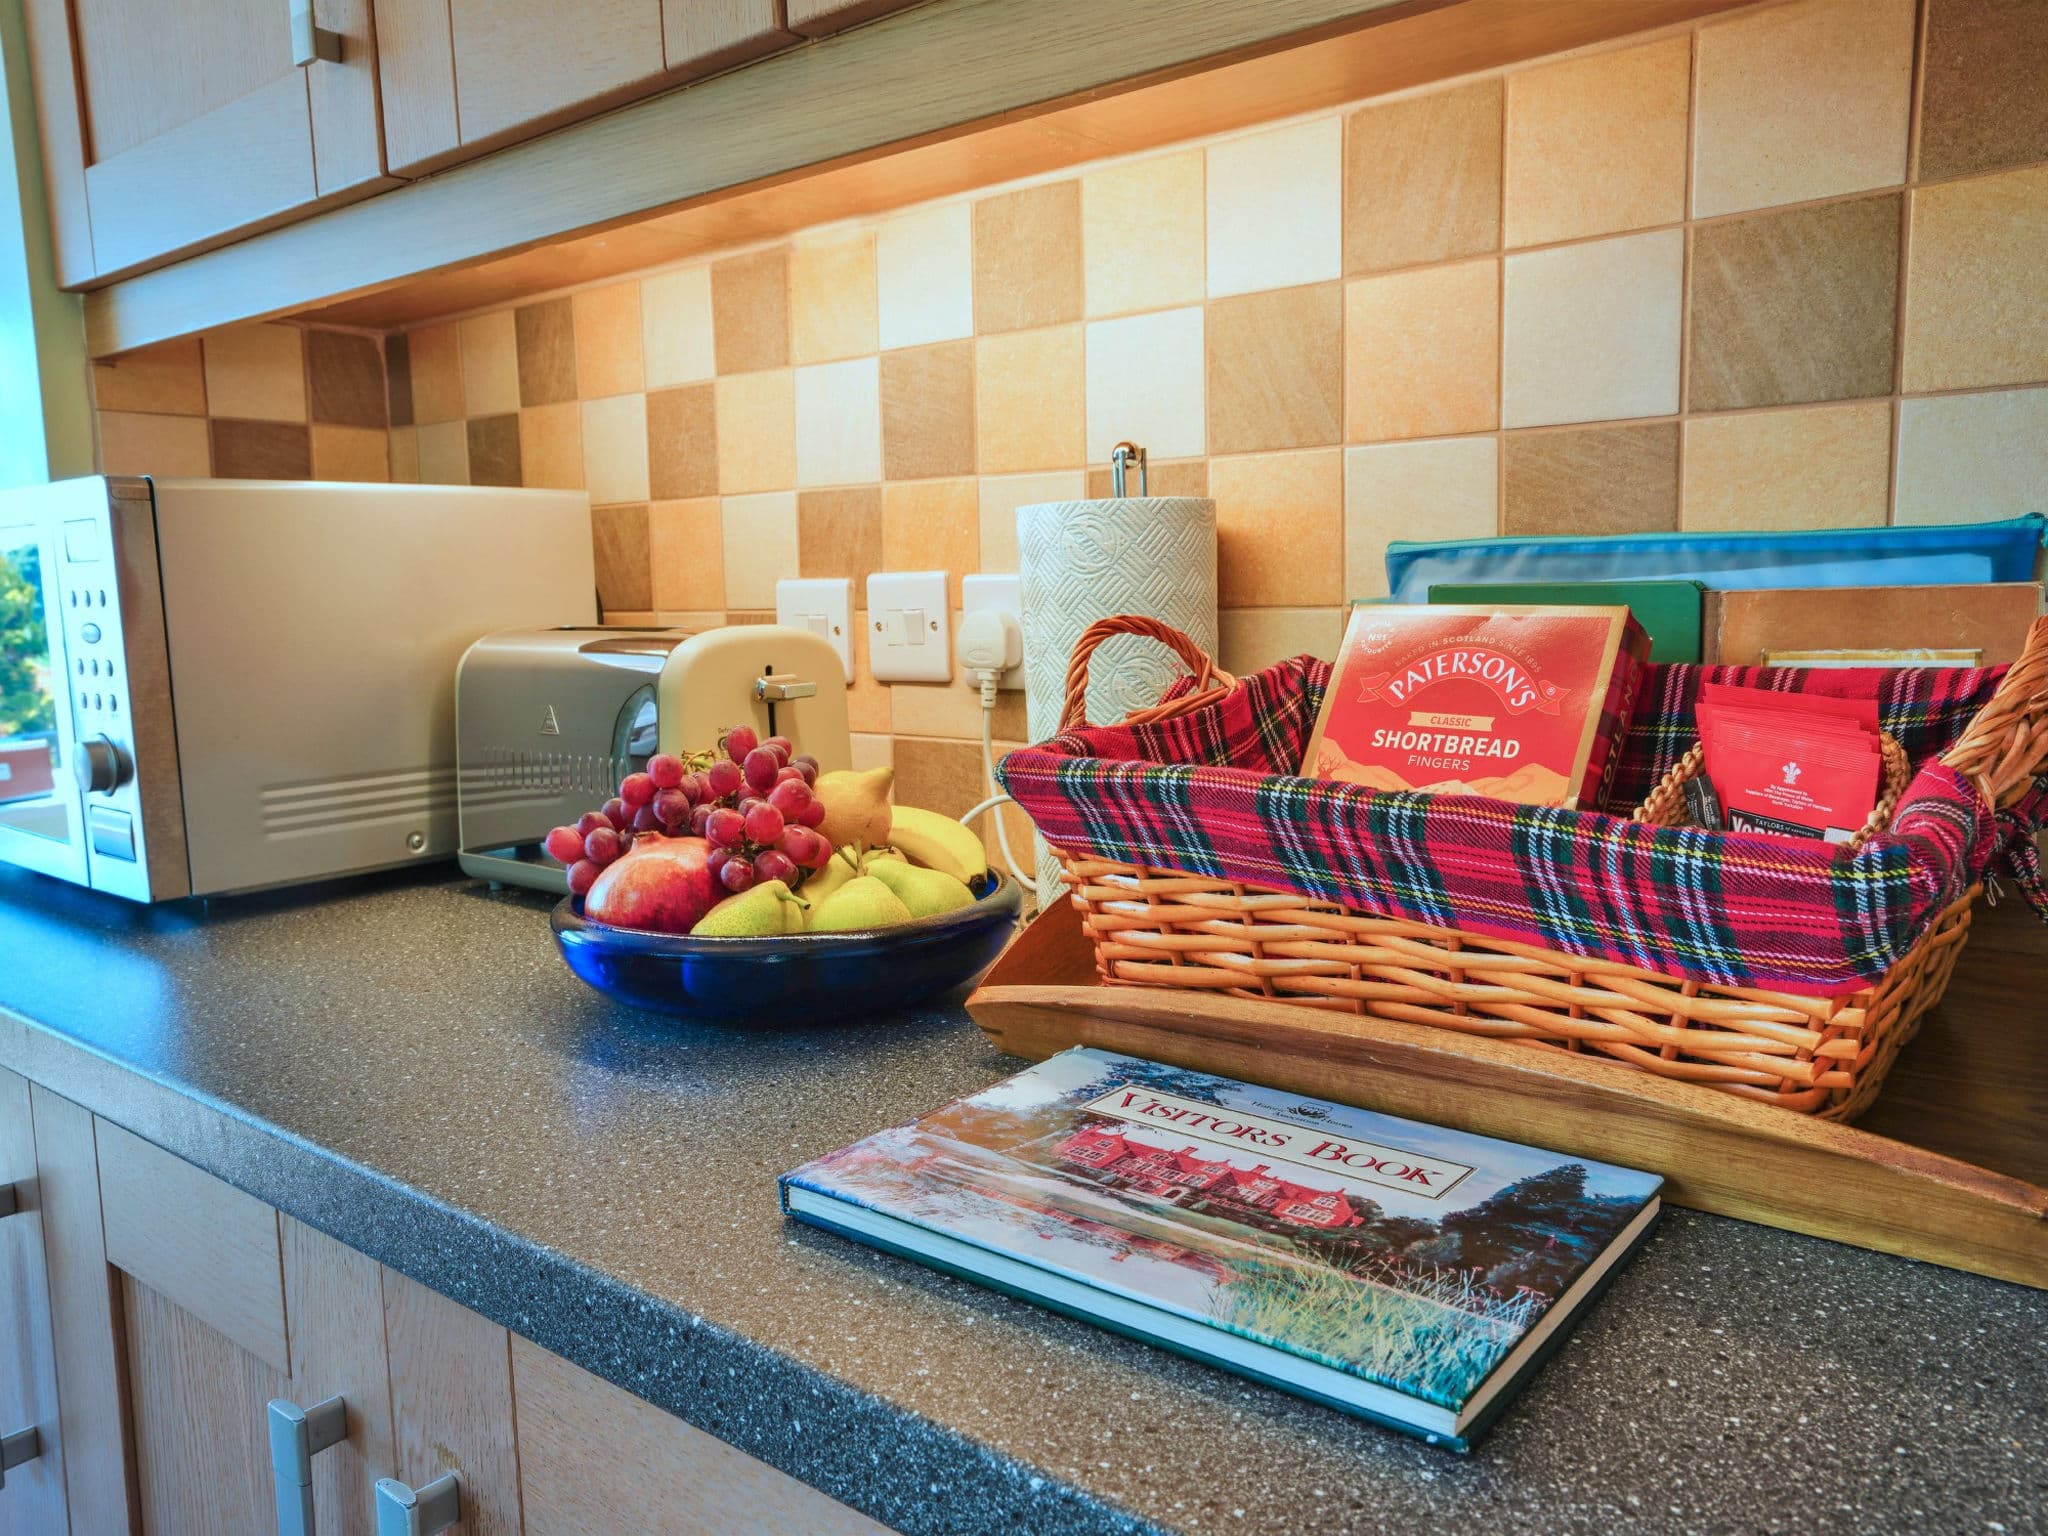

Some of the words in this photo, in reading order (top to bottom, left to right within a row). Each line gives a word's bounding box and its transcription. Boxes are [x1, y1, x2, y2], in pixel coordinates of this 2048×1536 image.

[1442, 635, 1496, 645] SCOTLAND
[1499, 639, 1524, 657] SINCE
[1387, 651, 1536, 707] PATERSON'S
[1430, 716, 1472, 727] CLASSIC
[1597, 663, 1639, 805] COTLAND
[1371, 729, 1520, 759] SHORTBREAD
[1407, 755, 1470, 771] FINGERS
[1755, 818, 1785, 830] TAYLORS
[1117, 1091, 1293, 1147] VISITORS
[1303, 1140, 1443, 1186] BOOK
